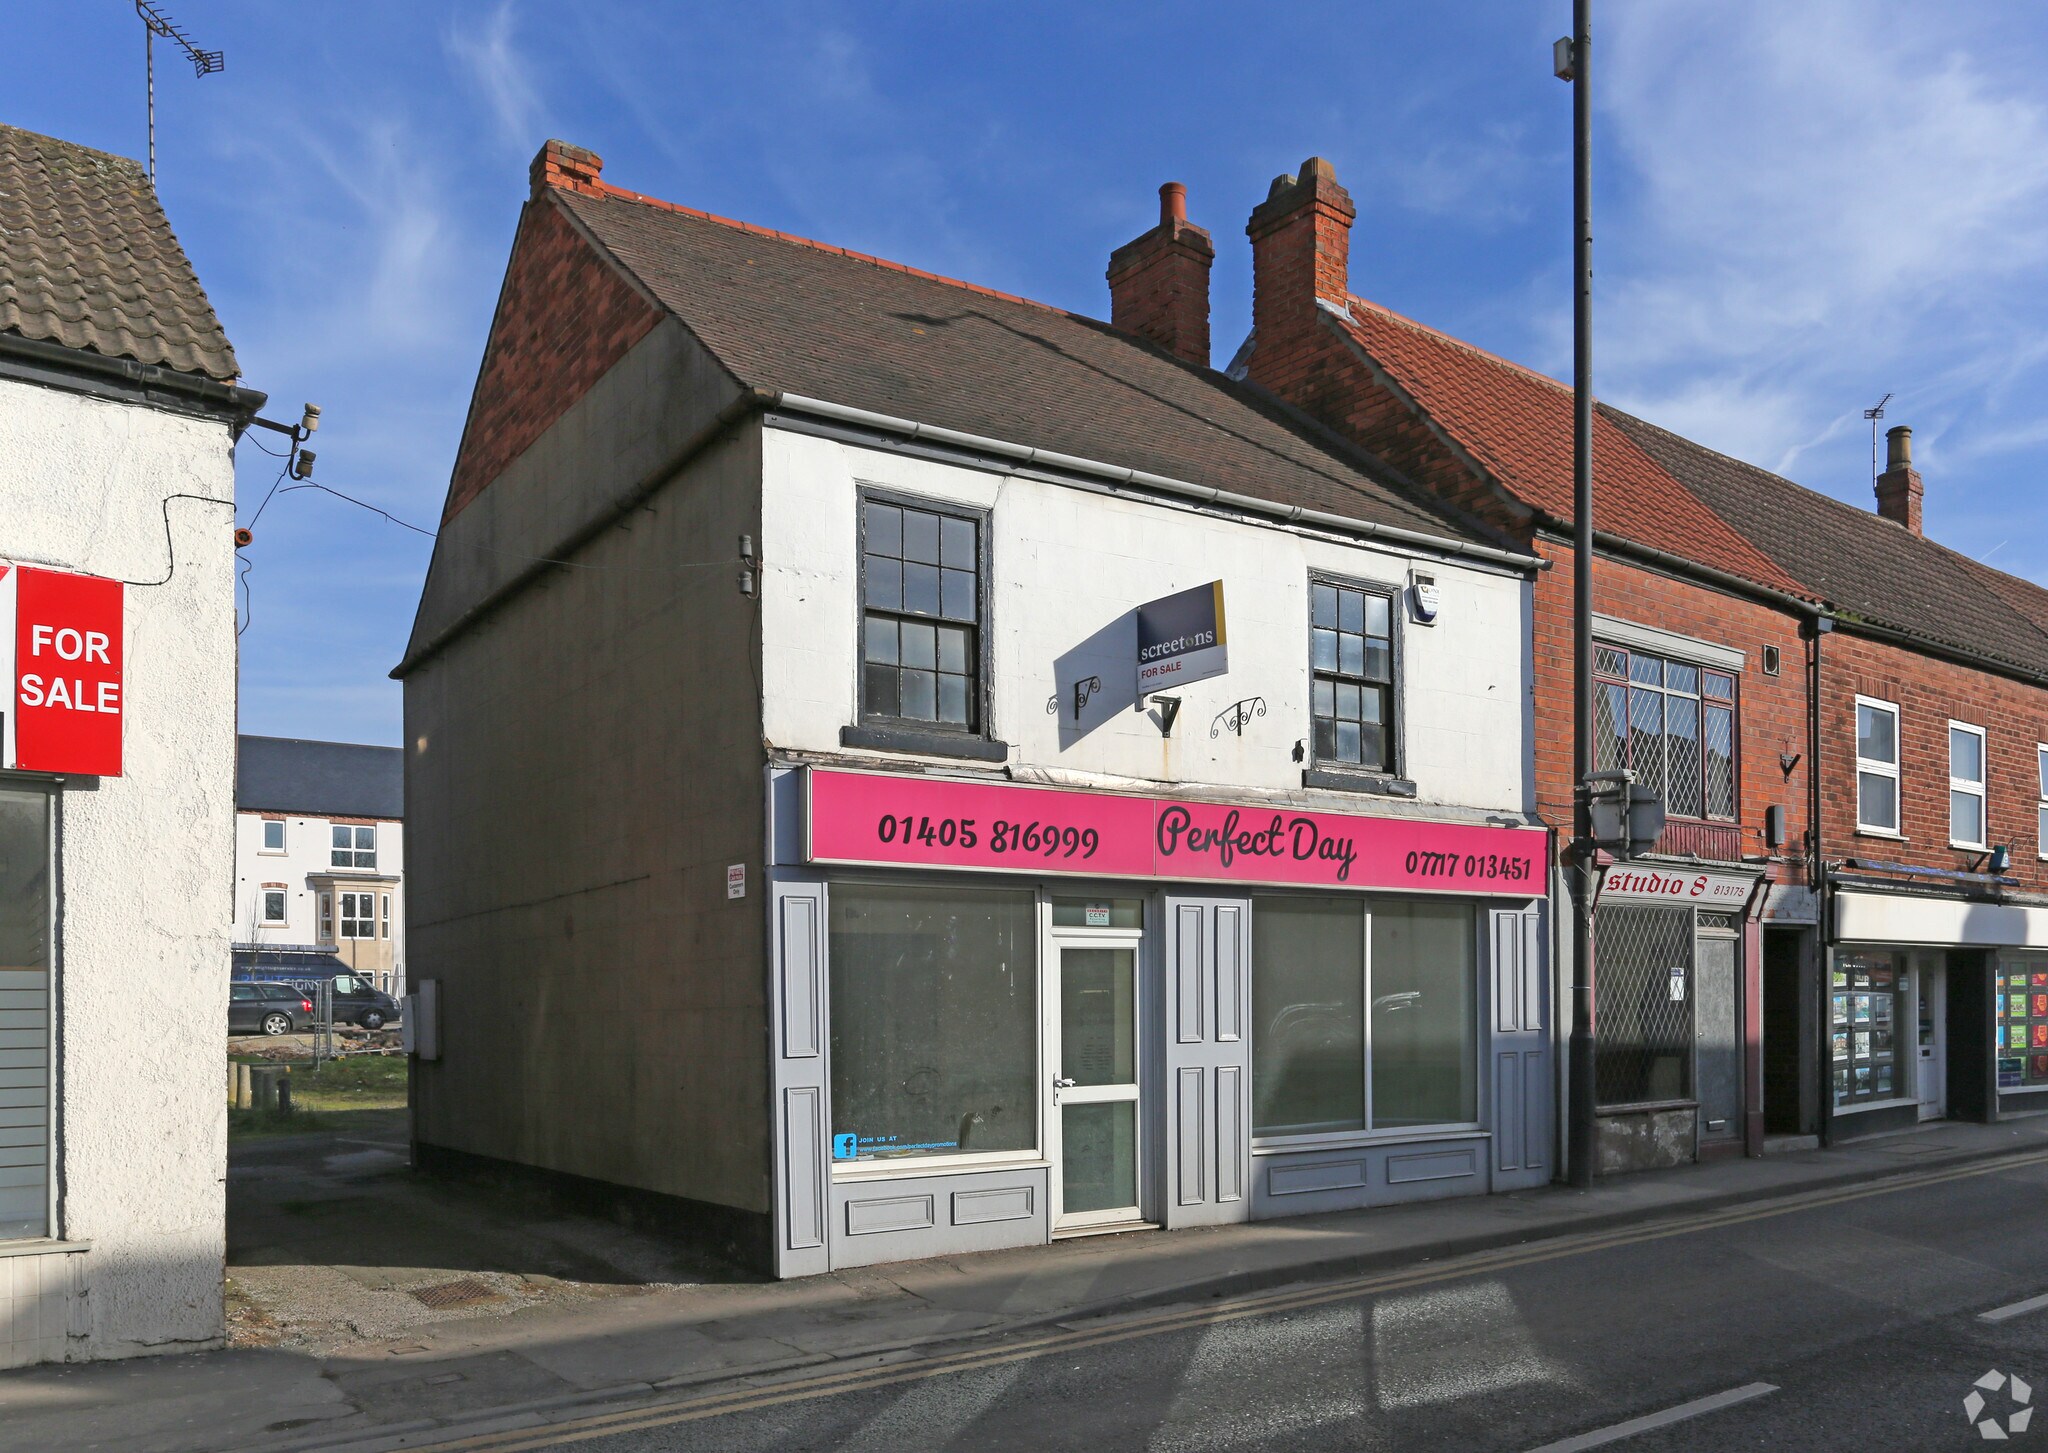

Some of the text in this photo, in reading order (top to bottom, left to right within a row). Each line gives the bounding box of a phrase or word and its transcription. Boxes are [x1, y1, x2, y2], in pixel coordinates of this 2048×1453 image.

[32, 624, 111, 665] FOR
[1141, 630, 1213, 661] screetons
[1141, 661, 1182, 680] FOR SALE
[20, 673, 120, 714] SALE
[877, 814, 1100, 859] 01405 816999
[1157, 805, 1358, 882] Perfect Day
[1405, 850, 1531, 880] 07717 013451
[1605, 871, 1708, 897] studio 8
[1713, 884, 1746, 898] 813175
